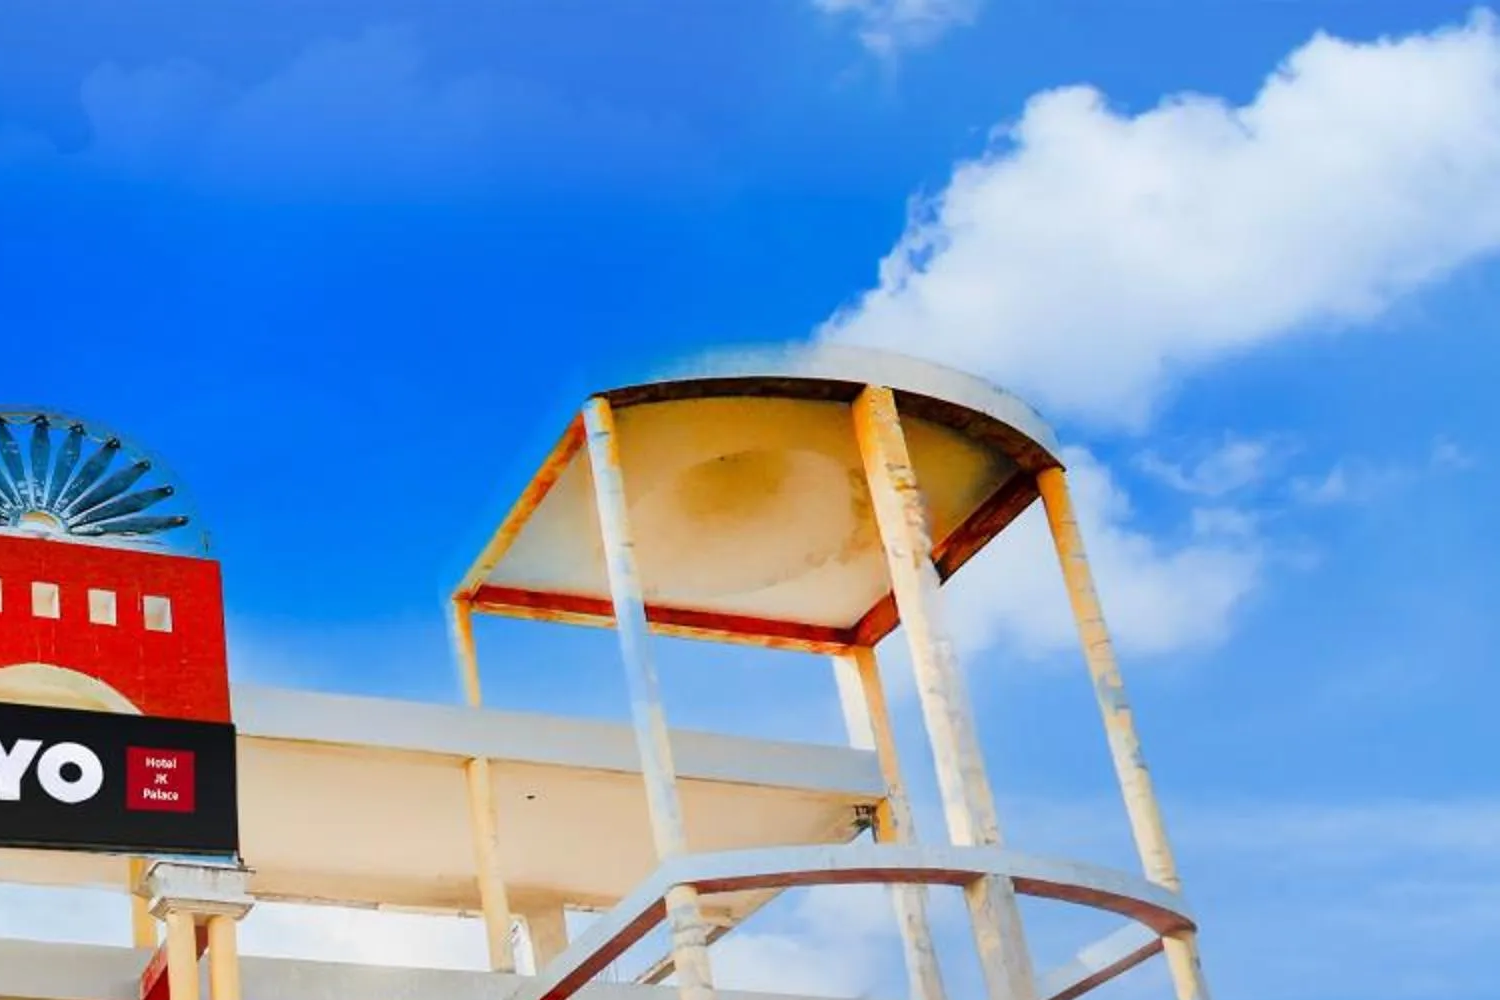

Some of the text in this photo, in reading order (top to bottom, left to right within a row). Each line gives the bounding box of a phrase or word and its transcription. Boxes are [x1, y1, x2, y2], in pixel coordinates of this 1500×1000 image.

[145, 756, 177, 769] Hotel
[154, 773, 169, 785] JK
[143, 787, 179, 801] Palace
